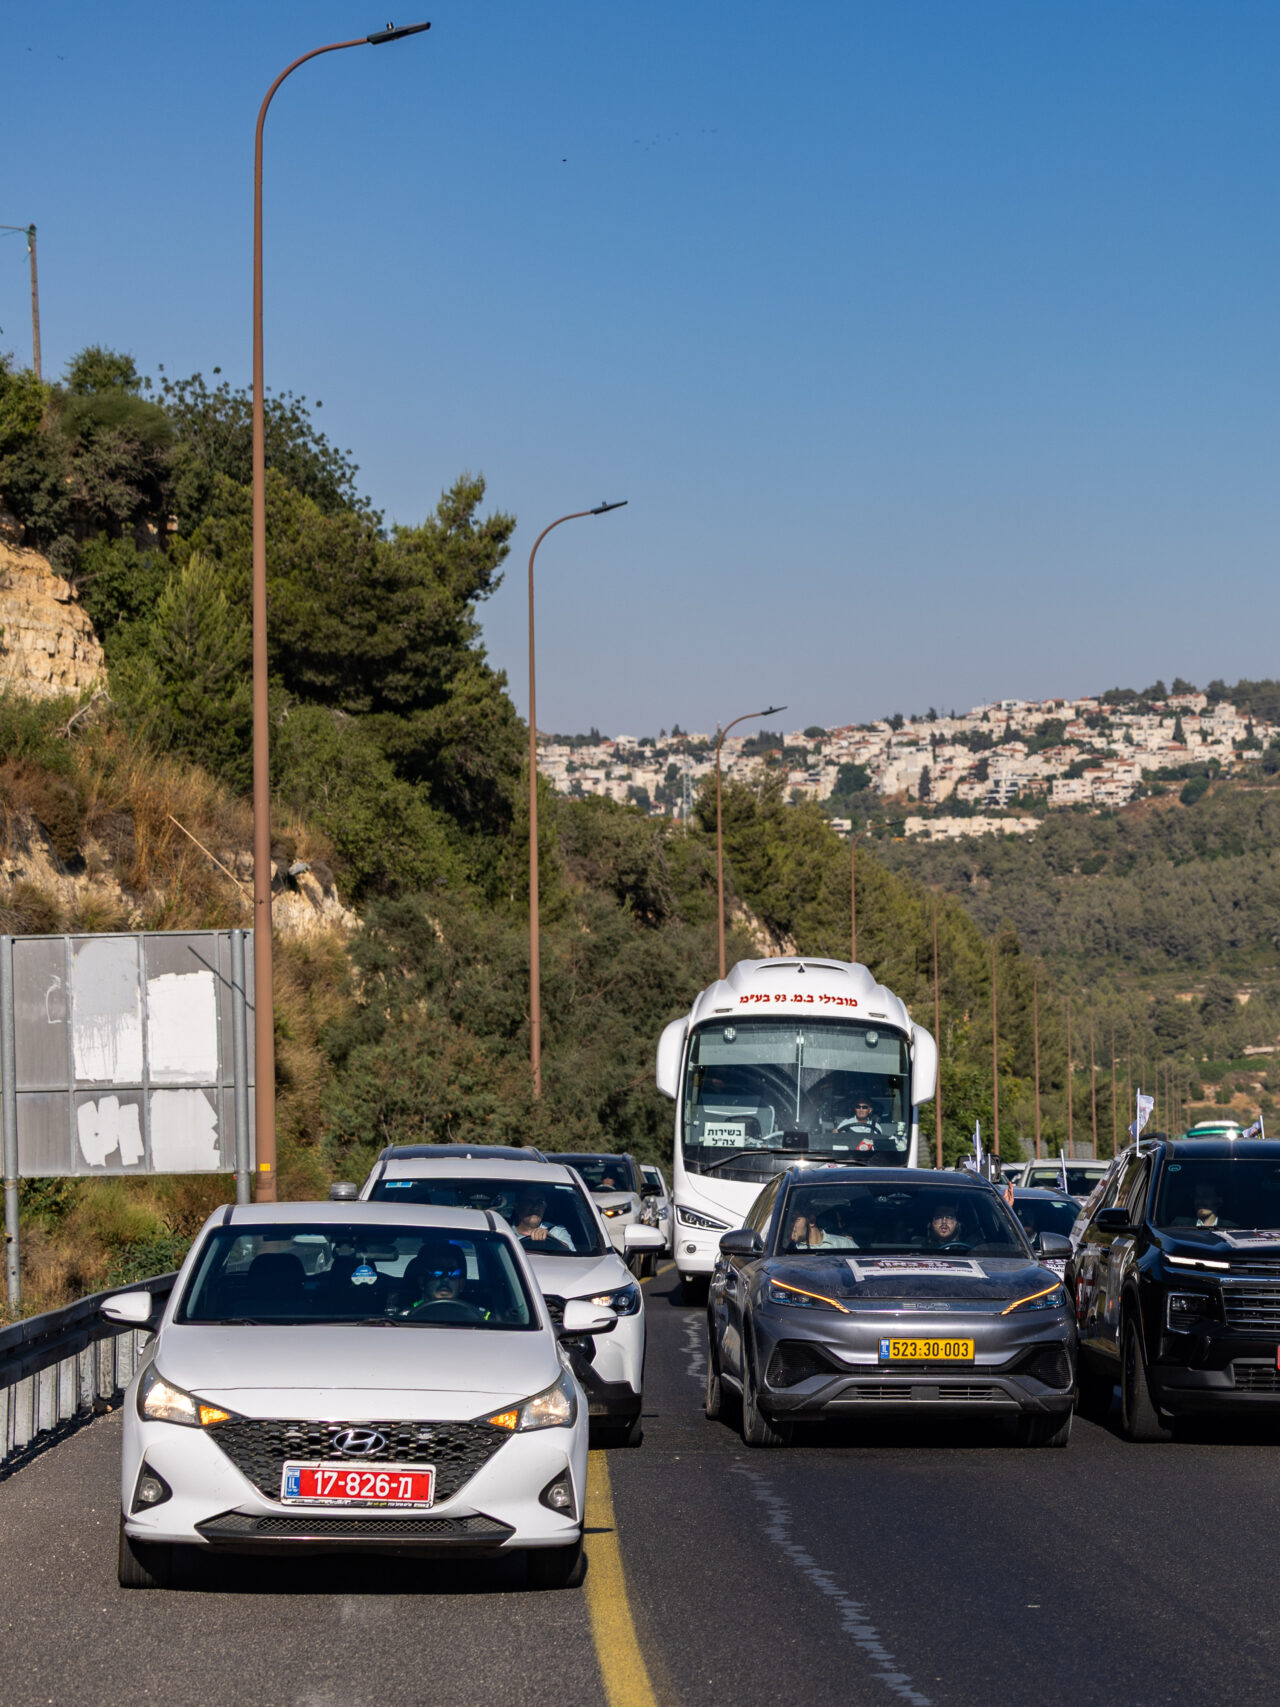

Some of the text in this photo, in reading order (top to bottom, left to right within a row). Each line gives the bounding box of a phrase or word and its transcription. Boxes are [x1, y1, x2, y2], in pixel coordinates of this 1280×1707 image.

[774, 994, 787, 1003] 93
[818, 994, 858, 1007] מובילי
[707, 1128, 742, 1136] בשירות
